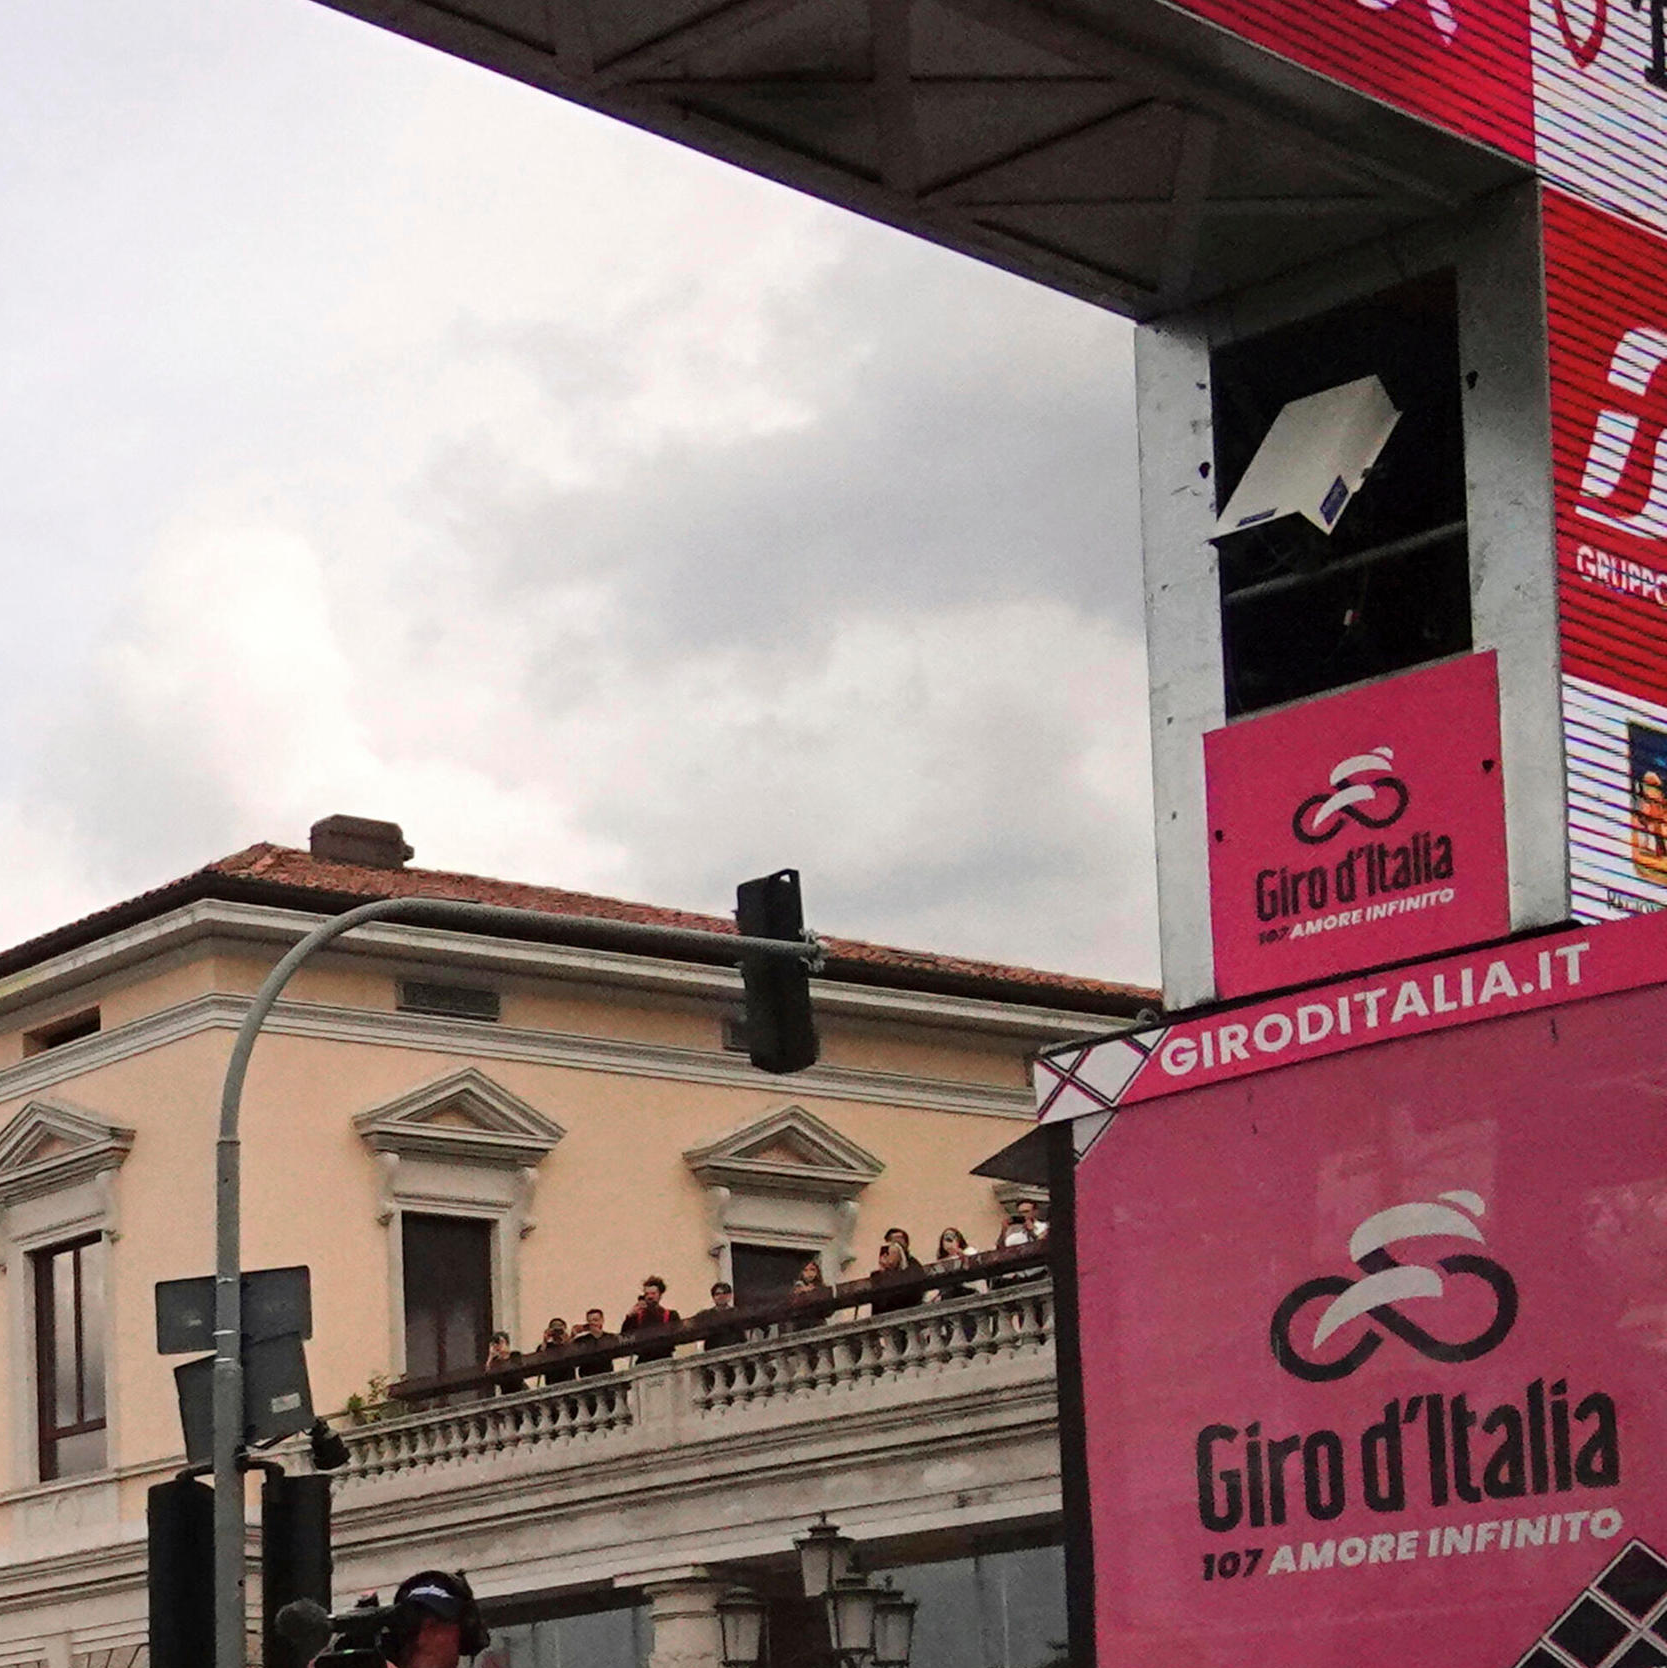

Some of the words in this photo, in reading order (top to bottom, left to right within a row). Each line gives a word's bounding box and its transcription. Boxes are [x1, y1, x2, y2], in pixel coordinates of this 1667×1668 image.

[1255, 865, 1329, 922] Giro
[1335, 831, 1454, 904] d'Italia
[1290, 907, 1364, 941] AMORE
[1365, 887, 1455, 922] INFINITO
[1160, 942, 1590, 1077] GIRODITALIA.IT
[1194, 1419, 1346, 1534] Giro
[1361, 1377, 1621, 1515] d'Italia
[1202, 1547, 1263, 1582] 107
[1267, 1528, 1417, 1577] AMORE
[1427, 1507, 1624, 1557] INFINITO
